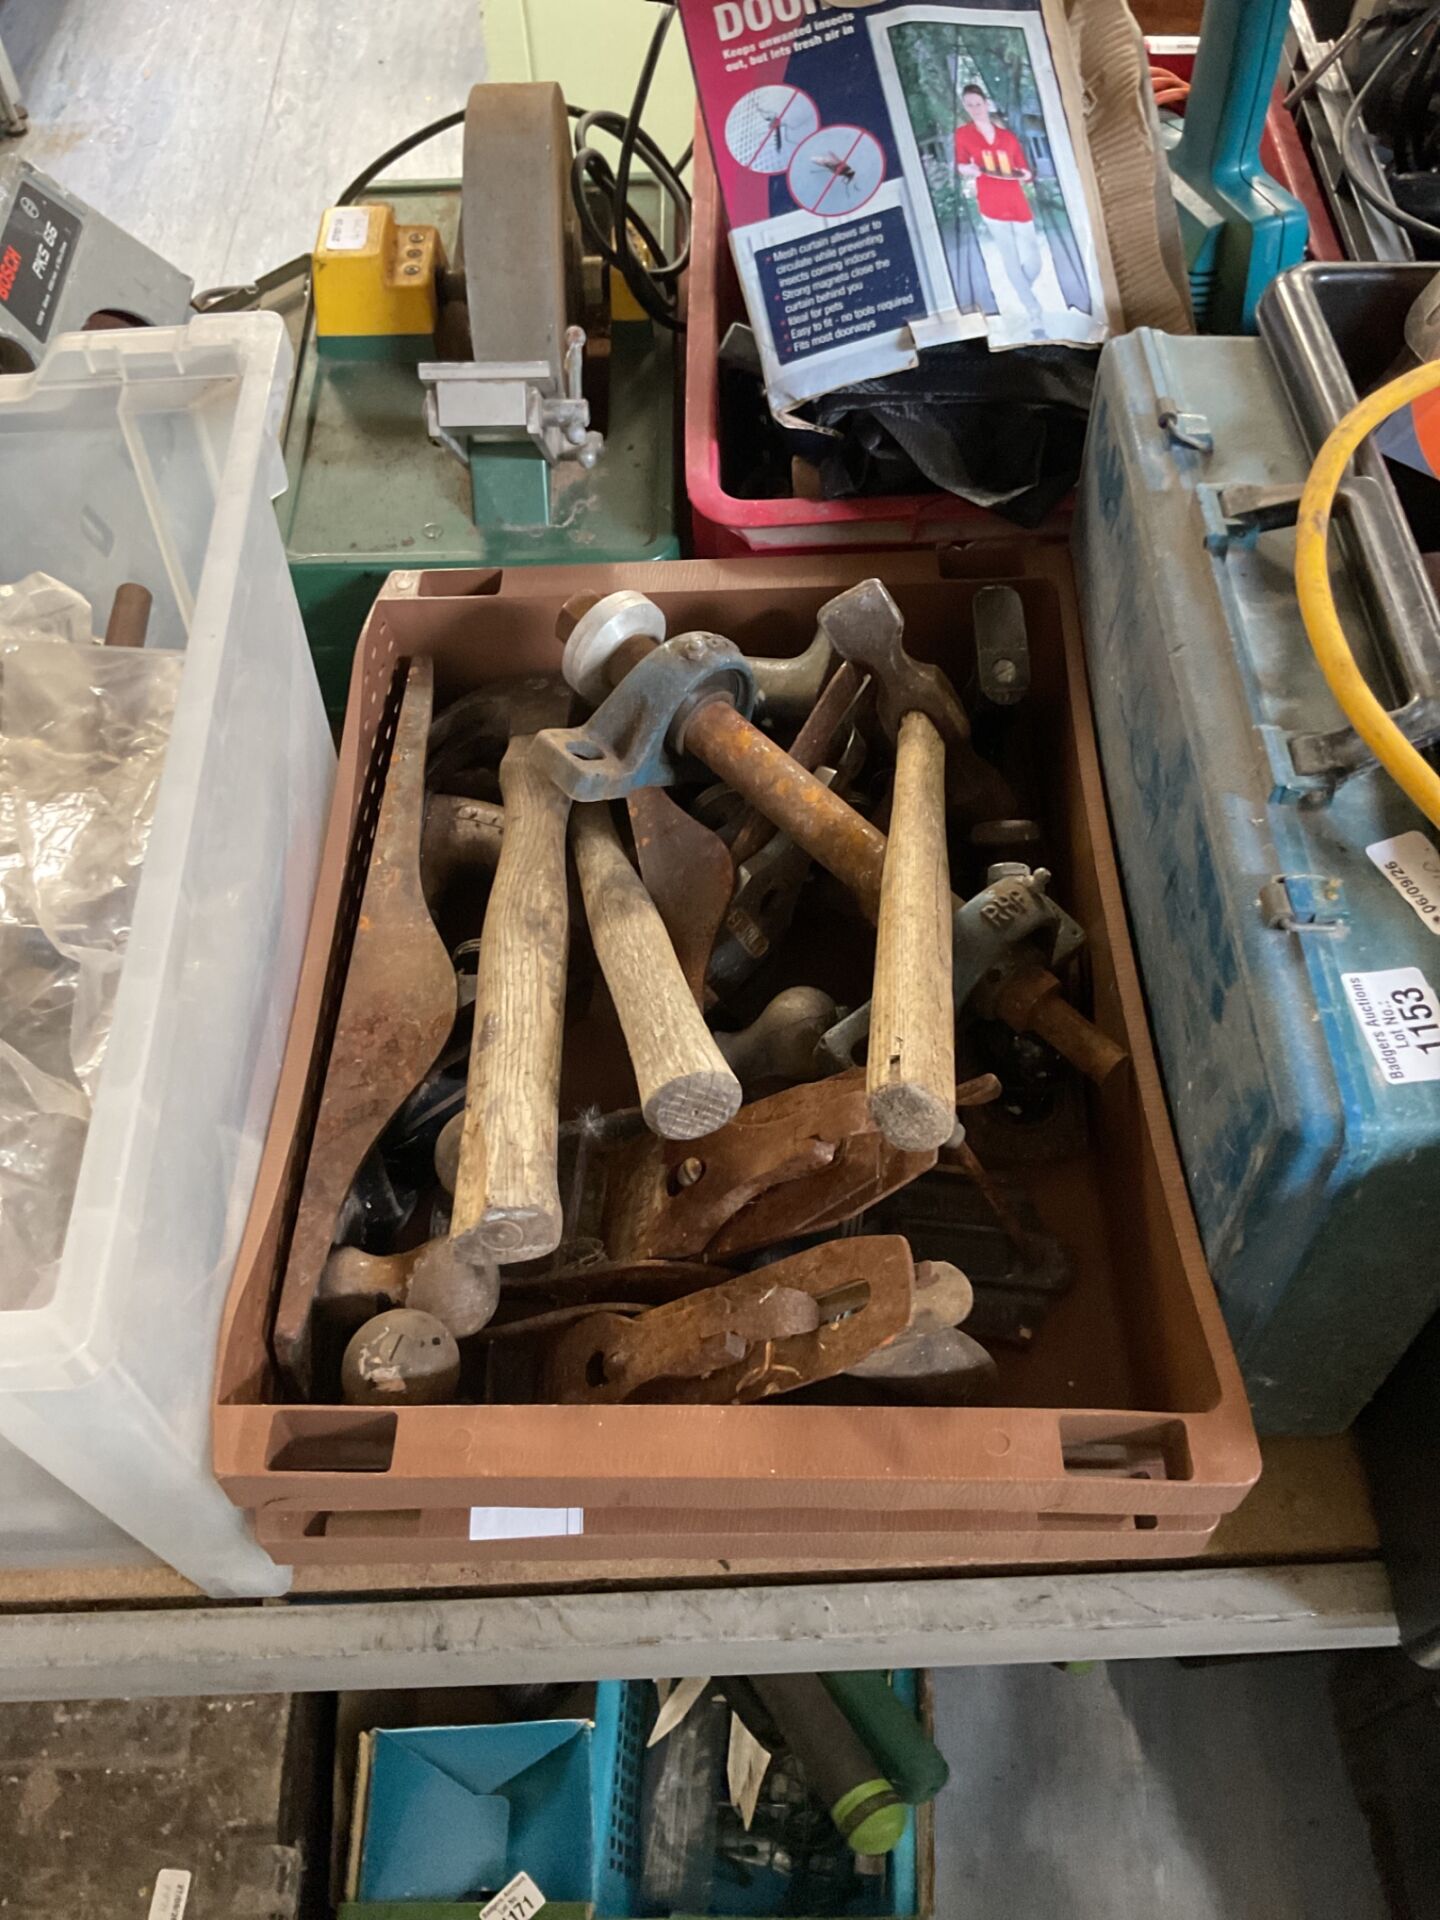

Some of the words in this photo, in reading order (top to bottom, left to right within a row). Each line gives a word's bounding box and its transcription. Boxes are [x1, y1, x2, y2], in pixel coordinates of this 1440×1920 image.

[713, 0, 834, 41] DOO
[722, 44, 757, 59] Keeps
[758, 23, 812, 49] unwanted
[813, 12, 855, 31] insects
[748, 52, 769, 66] but
[769, 46, 792, 59] lets
[793, 35, 823, 52] fresh
[824, 30, 840, 42] air
[842, 25, 855, 36] in
[776, 256, 813, 275] circulate
[814, 248, 837, 263] while
[838, 233, 884, 257] preventing
[799, 237, 829, 253] curtain
[830, 228, 858, 244] allows
[859, 223, 870, 235] air
[872, 220, 882, 230] to
[32, 243, 51, 280] PKS
[779, 272, 810, 288] insects
[810, 260, 843, 277] coming
[844, 249, 877, 266] indoors
[782, 285, 811, 300] Strong
[812, 272, 850, 290] magnets
[851, 264, 874, 278] close
[875, 258, 890, 270] the
[785, 297, 815, 314] curtain
[816, 287, 846, 302] behind
[847, 282, 864, 296] you
[791, 326, 812, 341] Easy
[813, 322, 823, 332] to
[823, 317, 834, 328] fit
[840, 313, 853, 323] no
[854, 304, 876, 319] tools
[877, 293, 915, 312] required
[810, 307, 822, 318] for
[824, 301, 844, 315] pets
[793, 339, 810, 352] Fits
[811, 332, 834, 346] most
[834, 319, 877, 339] doorways
[1350, 977, 1381, 1027] Auctions
[1391, 987, 1440, 1055] 1153
[1373, 1031, 1405, 1079] Badgers
[1389, 1030, 1409, 1048] Lot
[501, 1895, 535, 1920] 171
